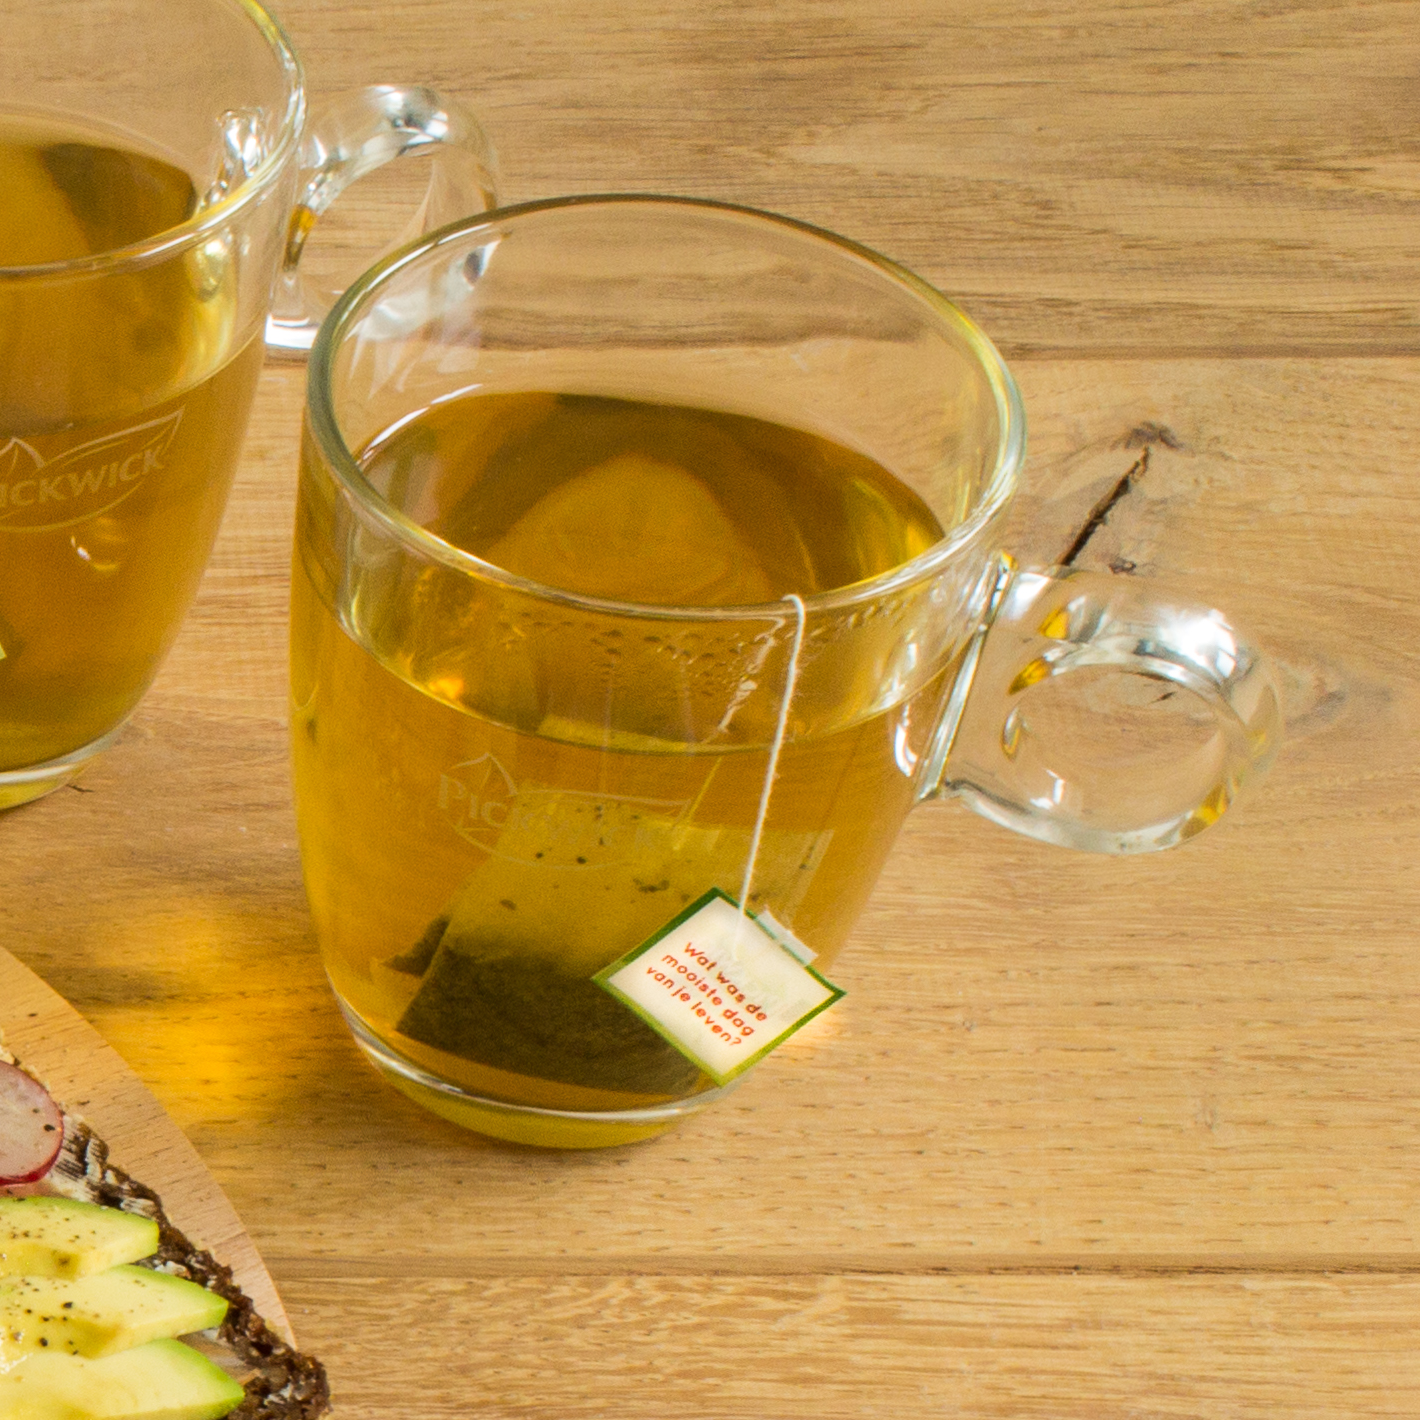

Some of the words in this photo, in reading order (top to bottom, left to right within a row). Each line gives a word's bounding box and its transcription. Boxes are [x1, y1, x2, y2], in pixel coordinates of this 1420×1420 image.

[646, 965, 674, 990] van
[671, 985, 691, 1003] je
[690, 1001, 742, 1047] leven?
[661, 953, 723, 1007] mooiste
[722, 1008, 755, 1037] dag
[683, 941, 717, 972] Wat
[715, 971, 746, 1004] was
[745, 1000, 767, 1022] de
